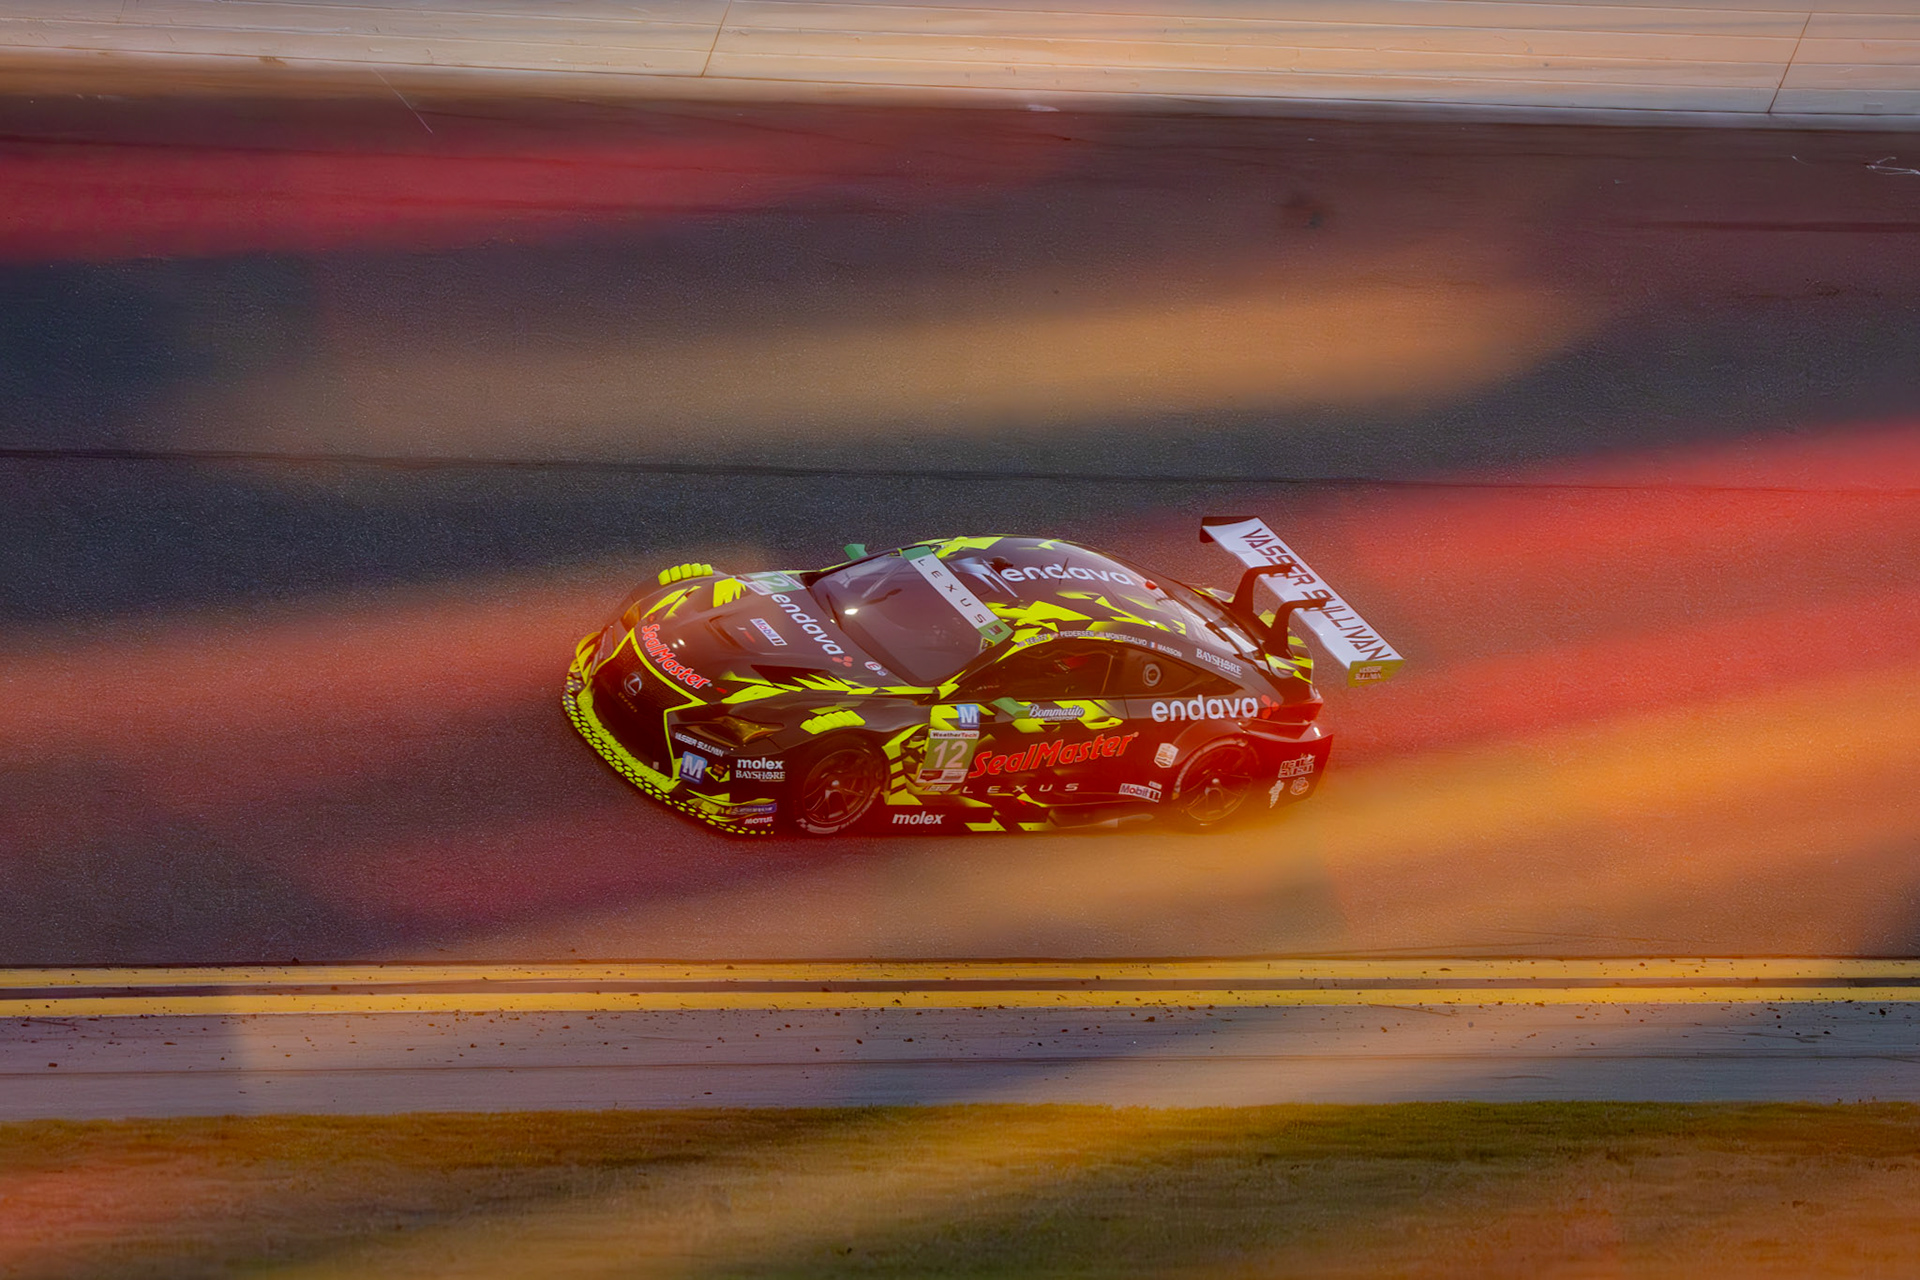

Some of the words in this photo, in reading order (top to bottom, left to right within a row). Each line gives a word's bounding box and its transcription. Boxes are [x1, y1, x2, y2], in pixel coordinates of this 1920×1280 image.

[1000, 563, 1135, 586] endava
[918, 559, 987, 623] LEXUS
[771, 594, 845, 655] endava
[641, 623, 711, 689] SealMaster
[1105, 632, 1147, 646] MONTECALVO
[1157, 643, 1182, 657] MASSON
[1196, 648, 1242, 674] BAYSHORE
[961, 706, 978, 723] M
[1028, 703, 1085, 718] Bommarito
[1151, 694, 1258, 722] endava
[737, 757, 784, 769] molex
[933, 740, 968, 769] 12
[968, 732, 1135, 779] SealMaster
[682, 755, 704, 779] M
[735, 769, 786, 780] BAYSHORE
[962, 783, 1080, 794] LEXUS
[1120, 784, 1149, 798] Mobil
[892, 810, 946, 825] molex
